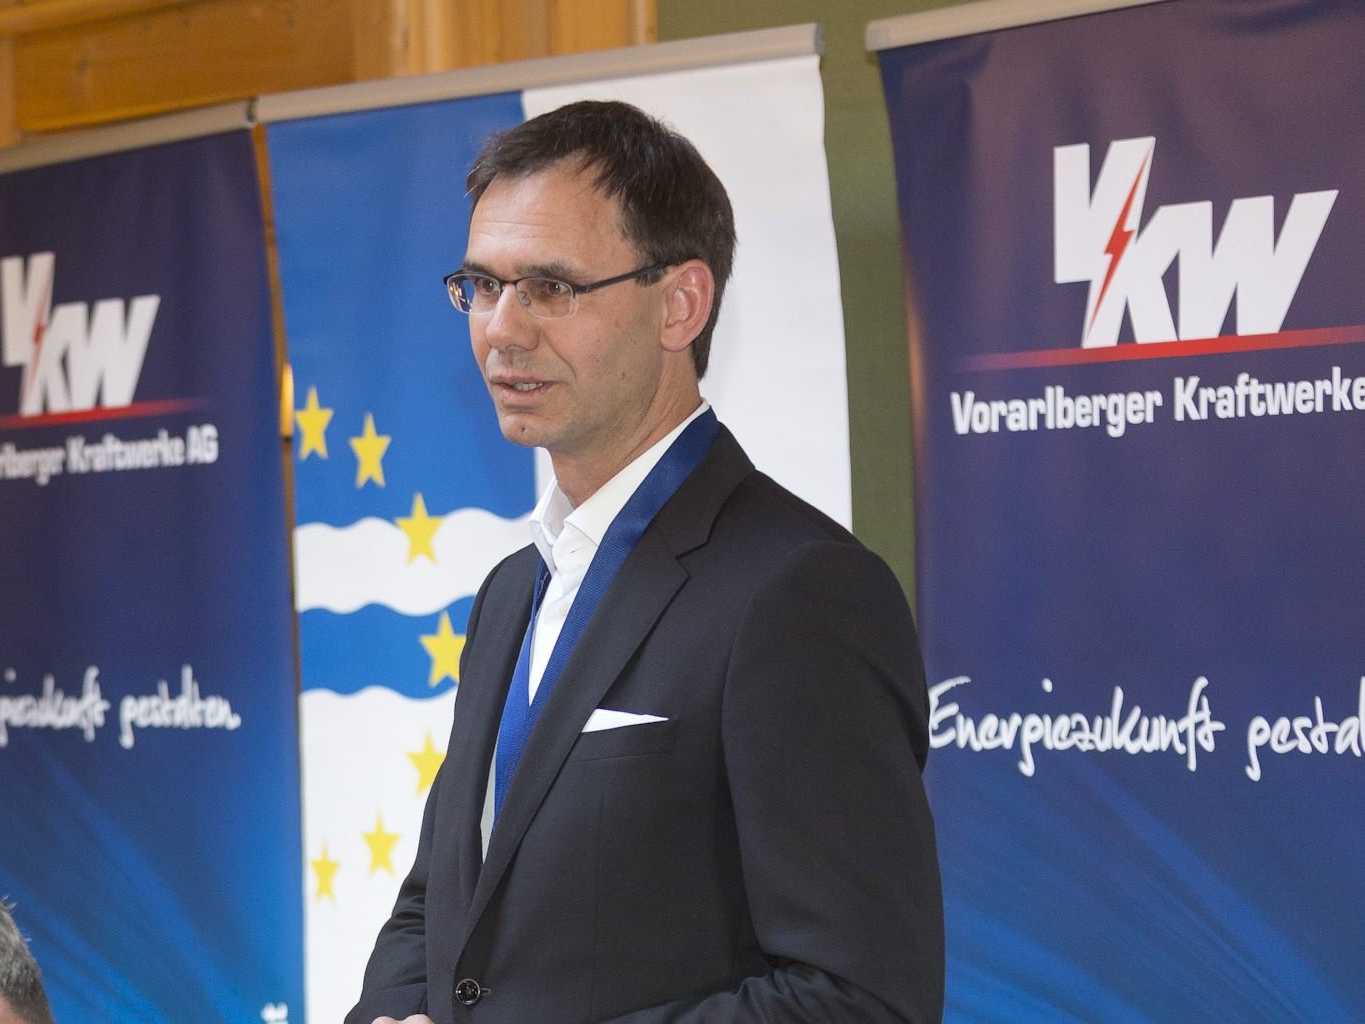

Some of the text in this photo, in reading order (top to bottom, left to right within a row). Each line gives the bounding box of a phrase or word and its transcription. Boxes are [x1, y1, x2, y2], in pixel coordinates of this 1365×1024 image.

[950, 366, 1365, 437] Vorarlberger Kraftwerke
[66, 428, 184, 473] Kraftwerke
[187, 424, 219, 464] AG
